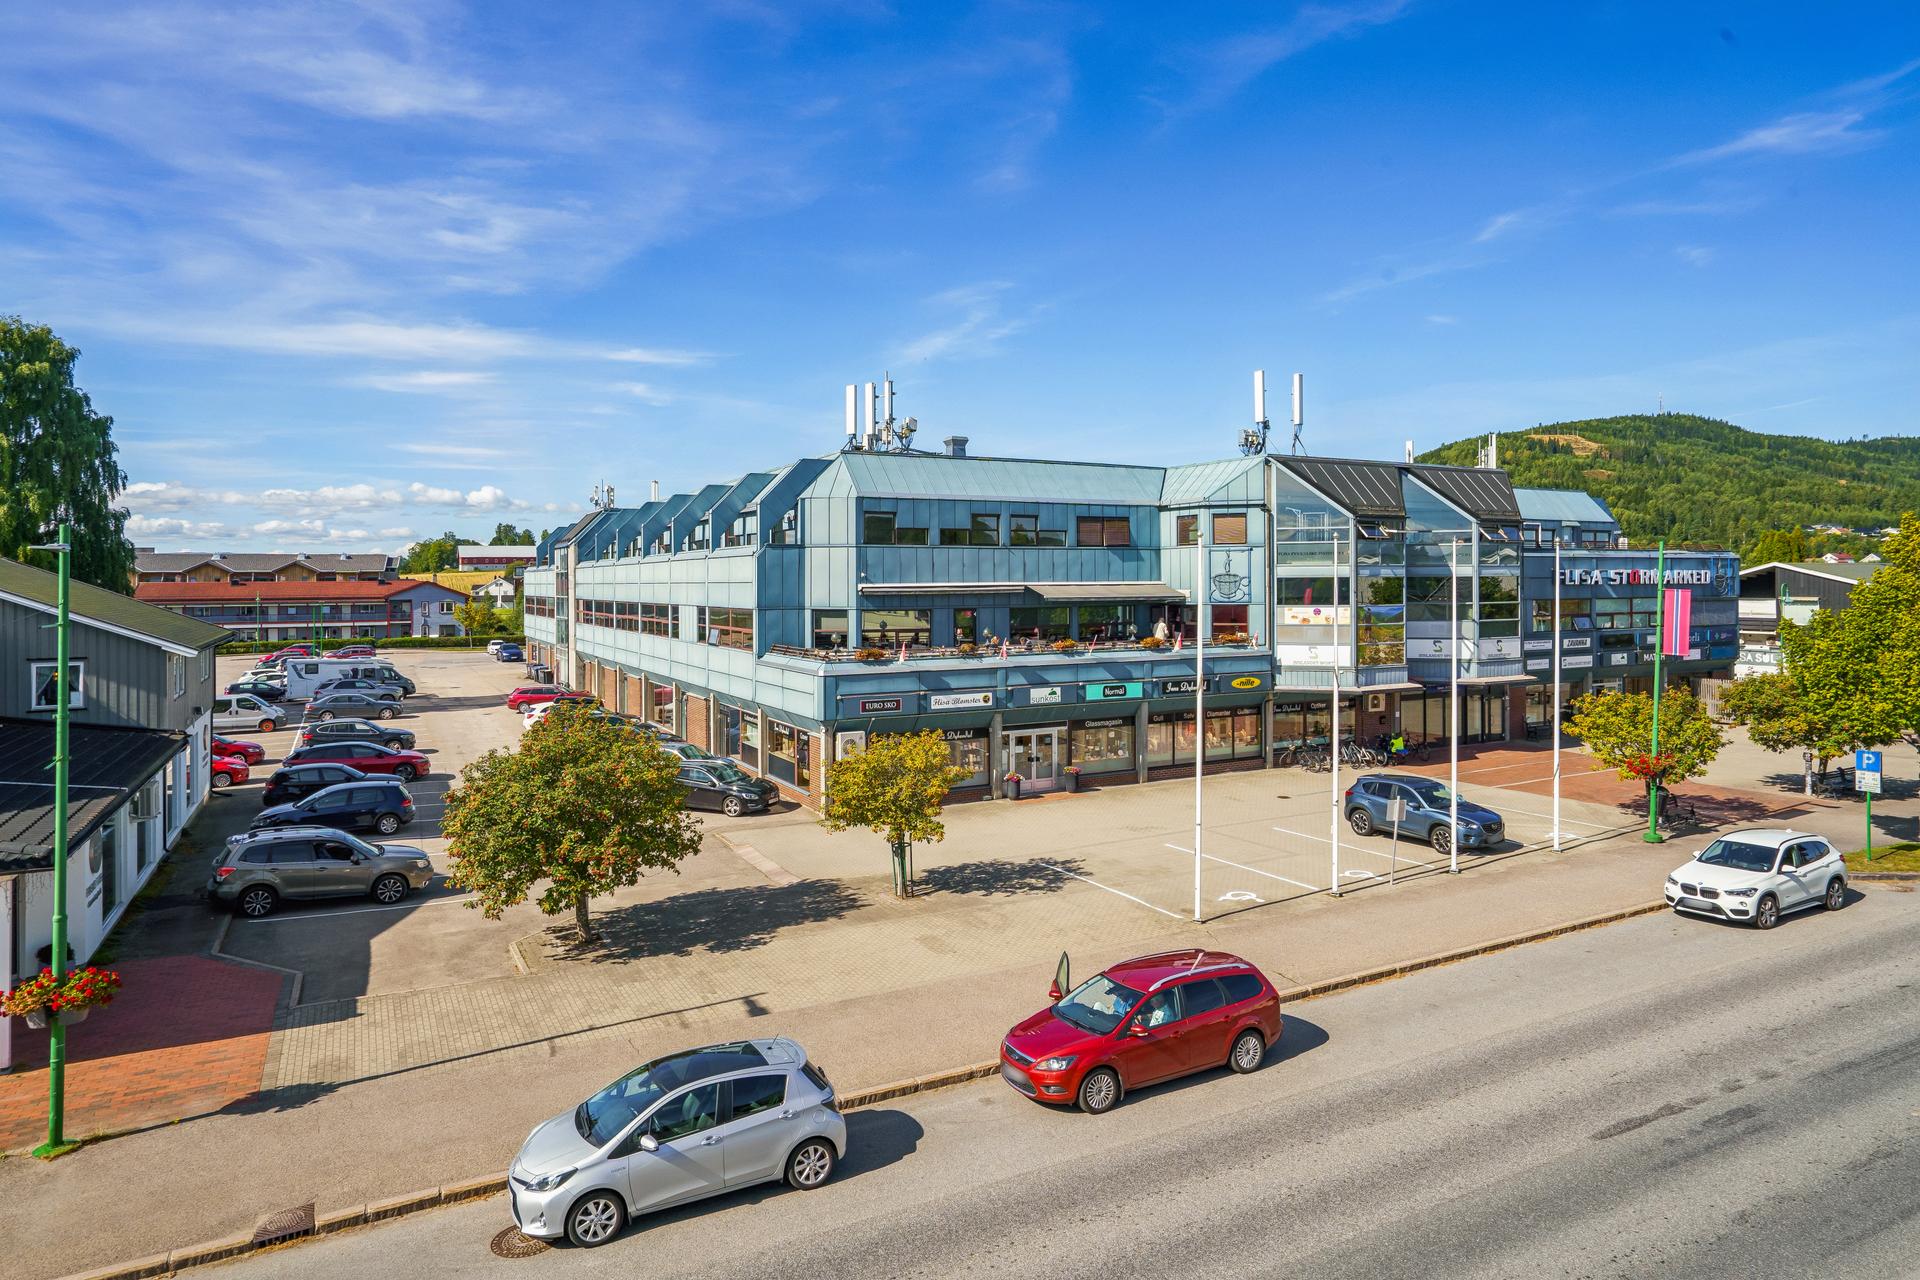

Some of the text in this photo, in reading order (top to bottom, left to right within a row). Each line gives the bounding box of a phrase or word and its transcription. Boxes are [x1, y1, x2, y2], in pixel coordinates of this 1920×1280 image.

[1104, 687, 1125, 696] Normal
[951, 696, 981, 705] Blomster
[1032, 695, 1060, 704] sunkost
[866, 701, 897, 710] EURO SKO
[1085, 718, 1123, 728] Glassmagasin
[1862, 753, 1876, 769] P
